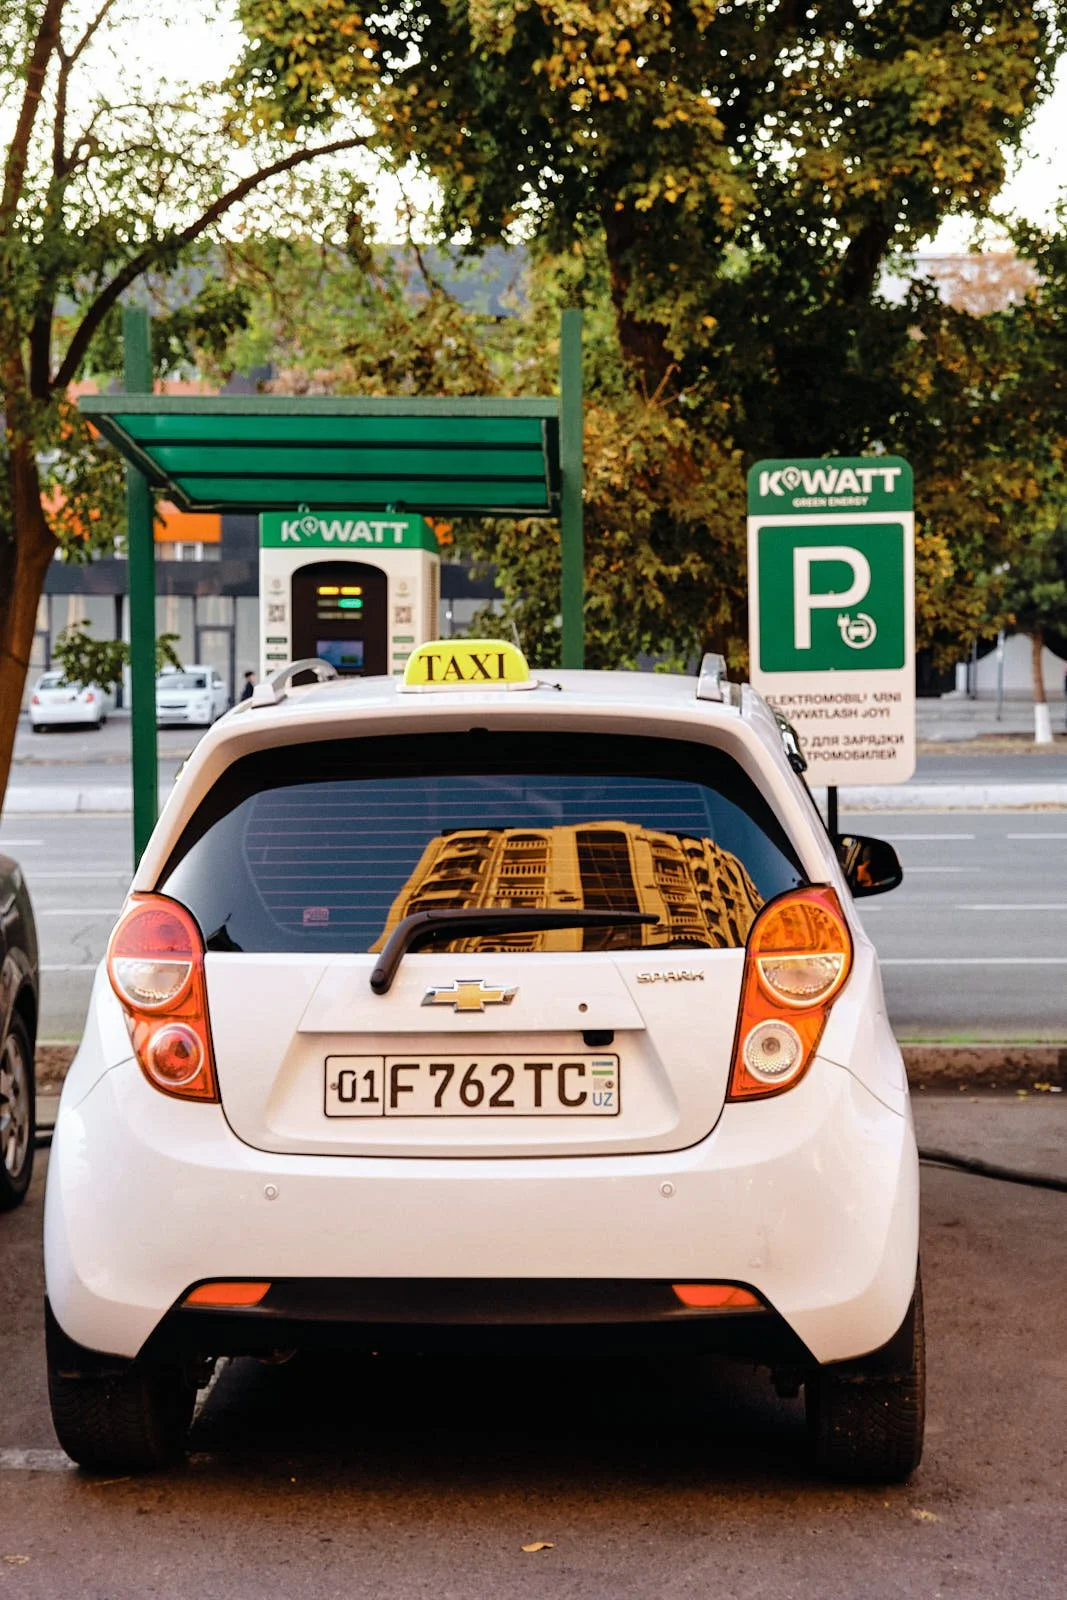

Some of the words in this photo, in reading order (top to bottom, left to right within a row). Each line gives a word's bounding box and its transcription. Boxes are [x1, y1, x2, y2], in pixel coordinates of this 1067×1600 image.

[791, 497, 827, 508] GREEN
[828, 496, 869, 507] ENERGY
[793, 545, 871, 650] P
[418, 652, 507, 682] TAXI
[785, 709, 859, 720] UVVATLASH
[811, 736, 839, 748] ДЛЯ
[843, 733, 905, 746] ЗАРЯДКИ
[806, 747, 897, 760] ТРОМОБИЛЕЙ
[636, 969, 705, 984] SPARK
[338, 1070, 379, 1103] 01
[592, 1092, 615, 1107] UZ
